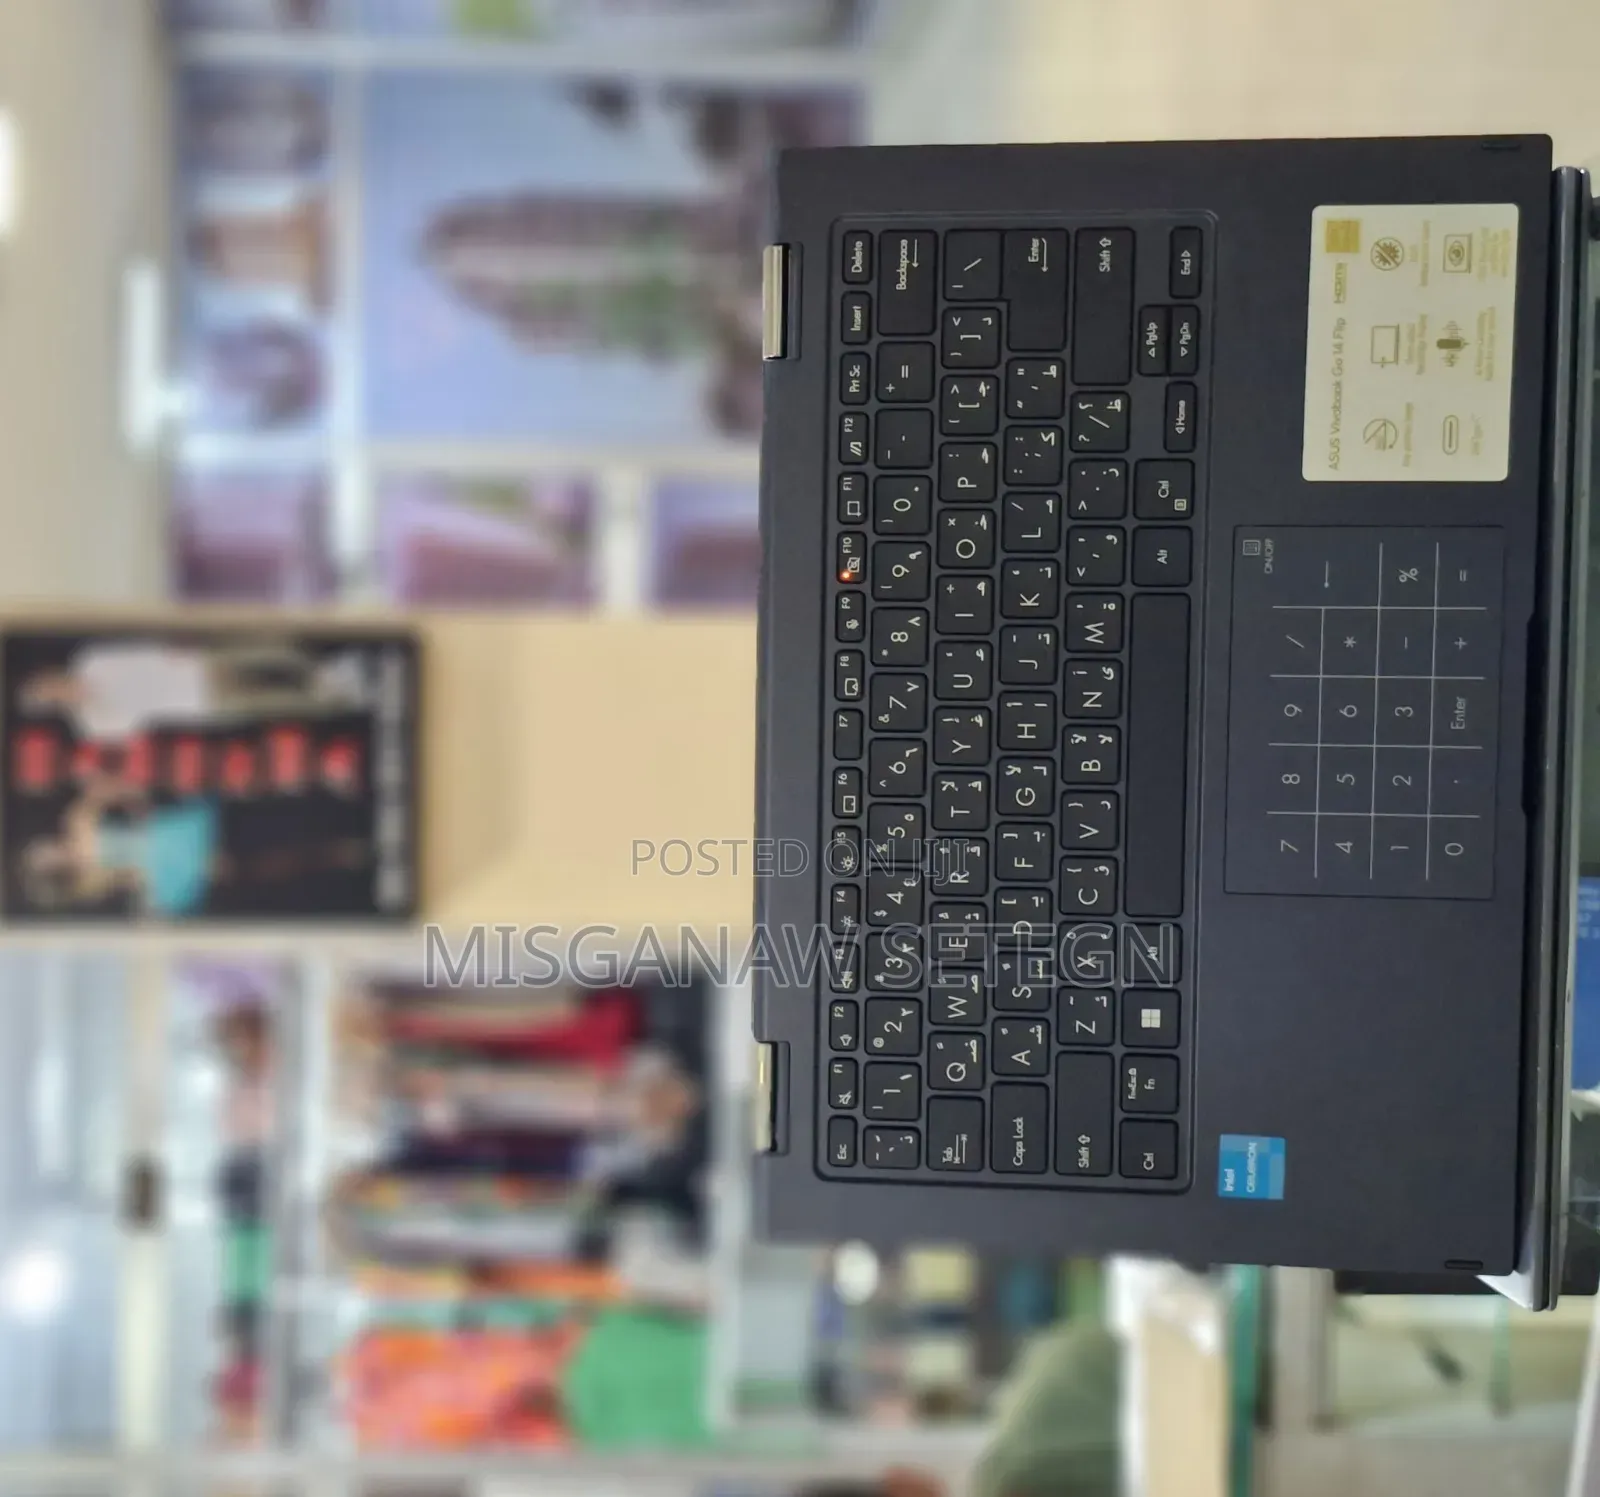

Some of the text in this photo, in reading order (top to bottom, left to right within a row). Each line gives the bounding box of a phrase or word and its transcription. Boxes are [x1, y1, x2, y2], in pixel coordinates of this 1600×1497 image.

[852, 240, 862, 272] Delete
[1028, 238, 1040, 262] Enter
[896, 240, 910, 290] Backspace
[1098, 250, 1110, 272] Shift
[1180, 258, 1190, 276] End
[850, 306, 862, 330] Insert
[1146, 322, 1158, 346] PgUp
[1180, 322, 1192, 344] PgDn
[1335, 317, 1346, 339] Flip
[1332, 358, 1343, 376] Go
[848, 364, 860, 392] Prt Sc
[1176, 400, 1186, 428] Home
[844, 418, 854, 432] F12
[1329, 438, 1341, 471] ASUS
[842, 478, 852, 490] F11
[958, 476, 976, 488] P
[1158, 480, 1170, 498] Ctrl
[1022, 526, 1042, 538] L
[842, 536, 852, 554] F10
[956, 538, 976, 558] O
[1156, 550, 1168, 564] Alt
[1264, 538, 1274, 574] ON/OFF
[892, 564, 910, 578] 9
[842, 596, 850, 610] F9
[1020, 592, 1040, 606] K
[890, 632, 908, 642] 8
[1084, 622, 1104, 644] M
[840, 656, 850, 666] F8
[1018, 660, 1038, 670] J
[952, 674, 972, 688] U
[890, 696, 906, 708] 7
[1082, 692, 1102, 708] N
[1284, 704, 1302, 716] 9
[1340, 704, 1358, 718] 6
[1394, 706, 1414, 716] 3
[1450, 696, 1466, 730] Enter
[838, 714, 848, 728] F7
[1016, 724, 1036, 738] H
[952, 740, 972, 754] Y
[888, 762, 906, 774] 6
[1080, 760, 1100, 772] B
[838, 774, 848, 784] F6
[1282, 774, 1300, 784] 8
[1336, 774, 1354, 786] 5
[1392, 774, 1412, 786] 2
[1016, 788, 1036, 806] G
[950, 806, 970, 818] T
[888, 826, 906, 838] 5
[1080, 824, 1098, 838] V
[1280, 840, 1298, 852] 7
[1336, 842, 1352, 854] 4
[1444, 842, 1464, 856] 0
[1014, 858, 1034, 868] F
[951, 872, 968, 883] R
[836, 890, 846, 902] F4
[886, 892, 904, 904] 4
[1078, 888, 1098, 904] C
[1014, 921, 1032, 934] D
[949, 938, 968, 947] E
[1148, 947, 1158, 961] Alt
[887, 957, 902, 969] 3
[1078, 956, 1096, 968] X
[1013, 986, 1031, 998] S
[834, 1006, 844, 1018] F2
[948, 996, 968, 1018] W
[884, 1022, 902, 1032] 2
[1076, 1020, 1096, 1034] Z
[1012, 1050, 1030, 1066] A
[834, 1064, 842, 1074] F1
[946, 1062, 966, 1082] Q
[1144, 1078, 1154, 1090] Fn
[1012, 1118, 1026, 1166] Caps Lock
[836, 1144, 846, 1160] Esc
[942, 1146, 956, 1164] Tab
[1078, 1146, 1090, 1168] Shift
[1144, 1152, 1154, 1170] Ctrl
